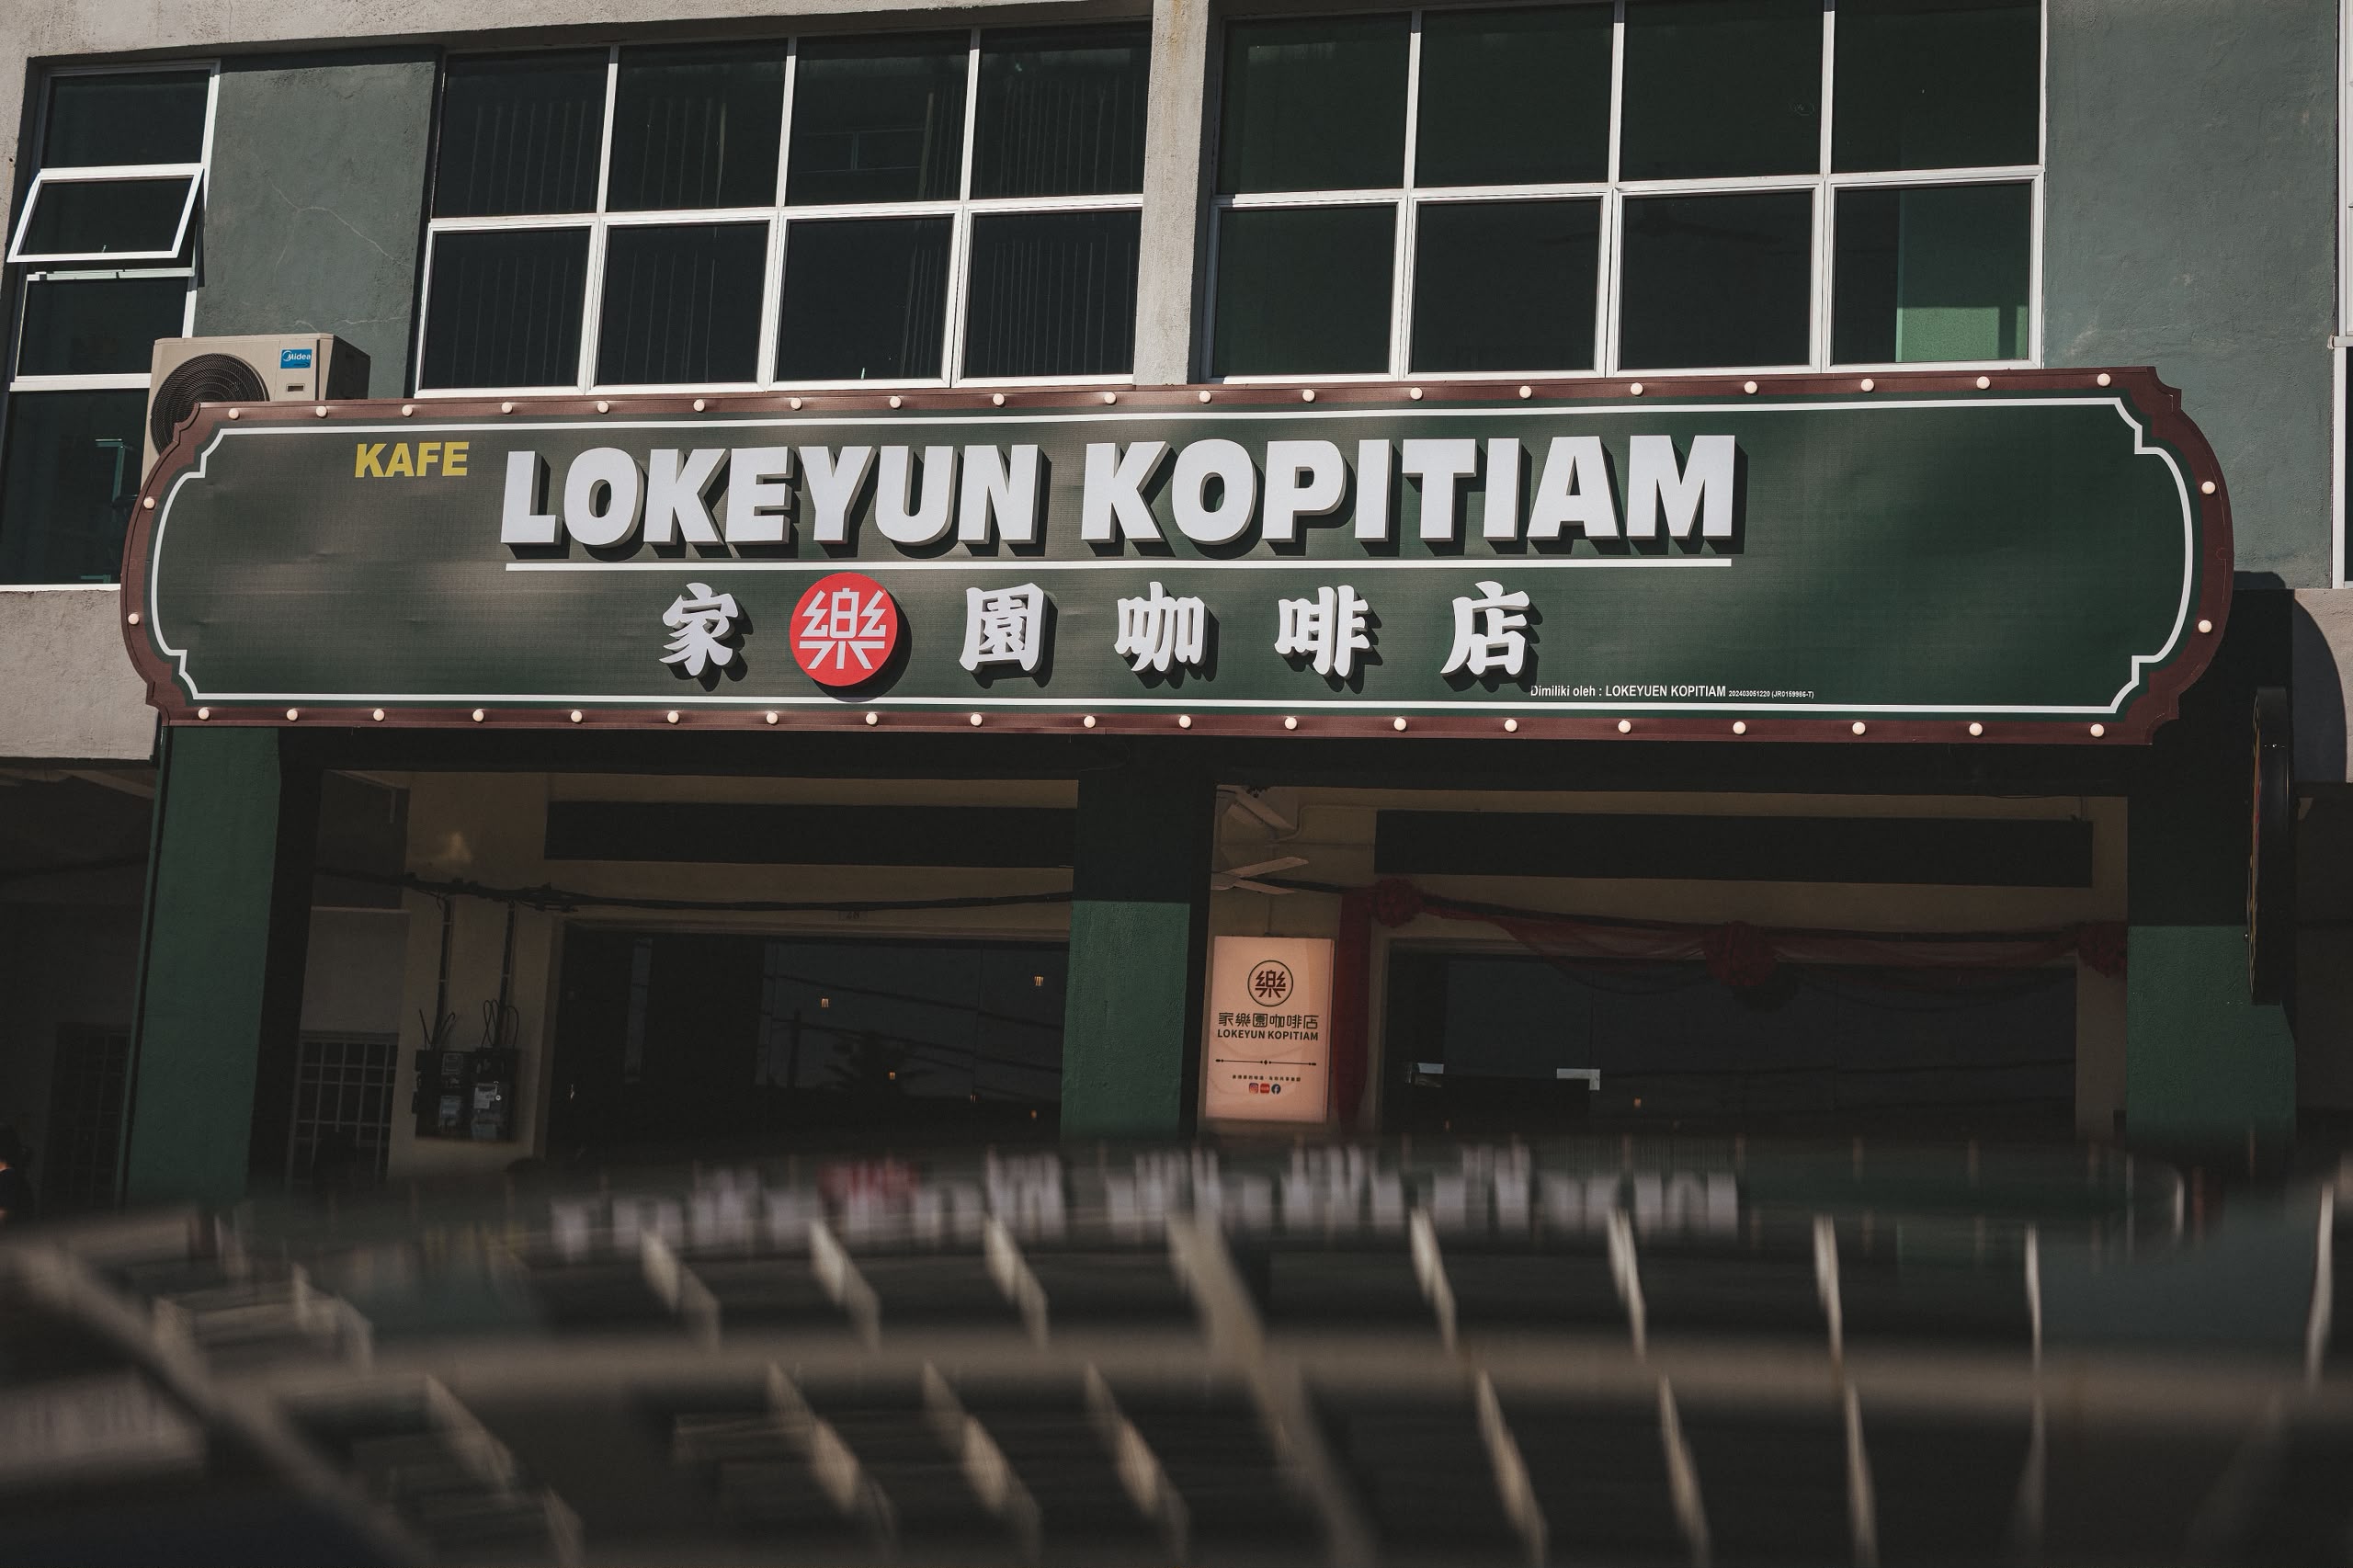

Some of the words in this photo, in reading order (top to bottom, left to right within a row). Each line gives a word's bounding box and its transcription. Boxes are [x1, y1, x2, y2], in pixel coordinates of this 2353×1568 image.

[282, 350, 312, 362] Midea
[355, 441, 470, 478] KAFE
[501, 444, 1043, 546] LOKEYUN
[1081, 435, 1737, 544] KOPITIAM
[1530, 685, 1570, 697] Dimiliki
[1573, 685, 1596, 697] oleh
[1605, 685, 1667, 698] LOKEYUEN
[1670, 686, 1726, 698] KOPITIAM
[1255, 969, 1286, 998] 樂
[1218, 1012, 1319, 1029] 家樂園咖啡店
[1217, 1028, 1266, 1039] LOKEYUN
[1267, 1030, 1319, 1040] KOPITIAM
